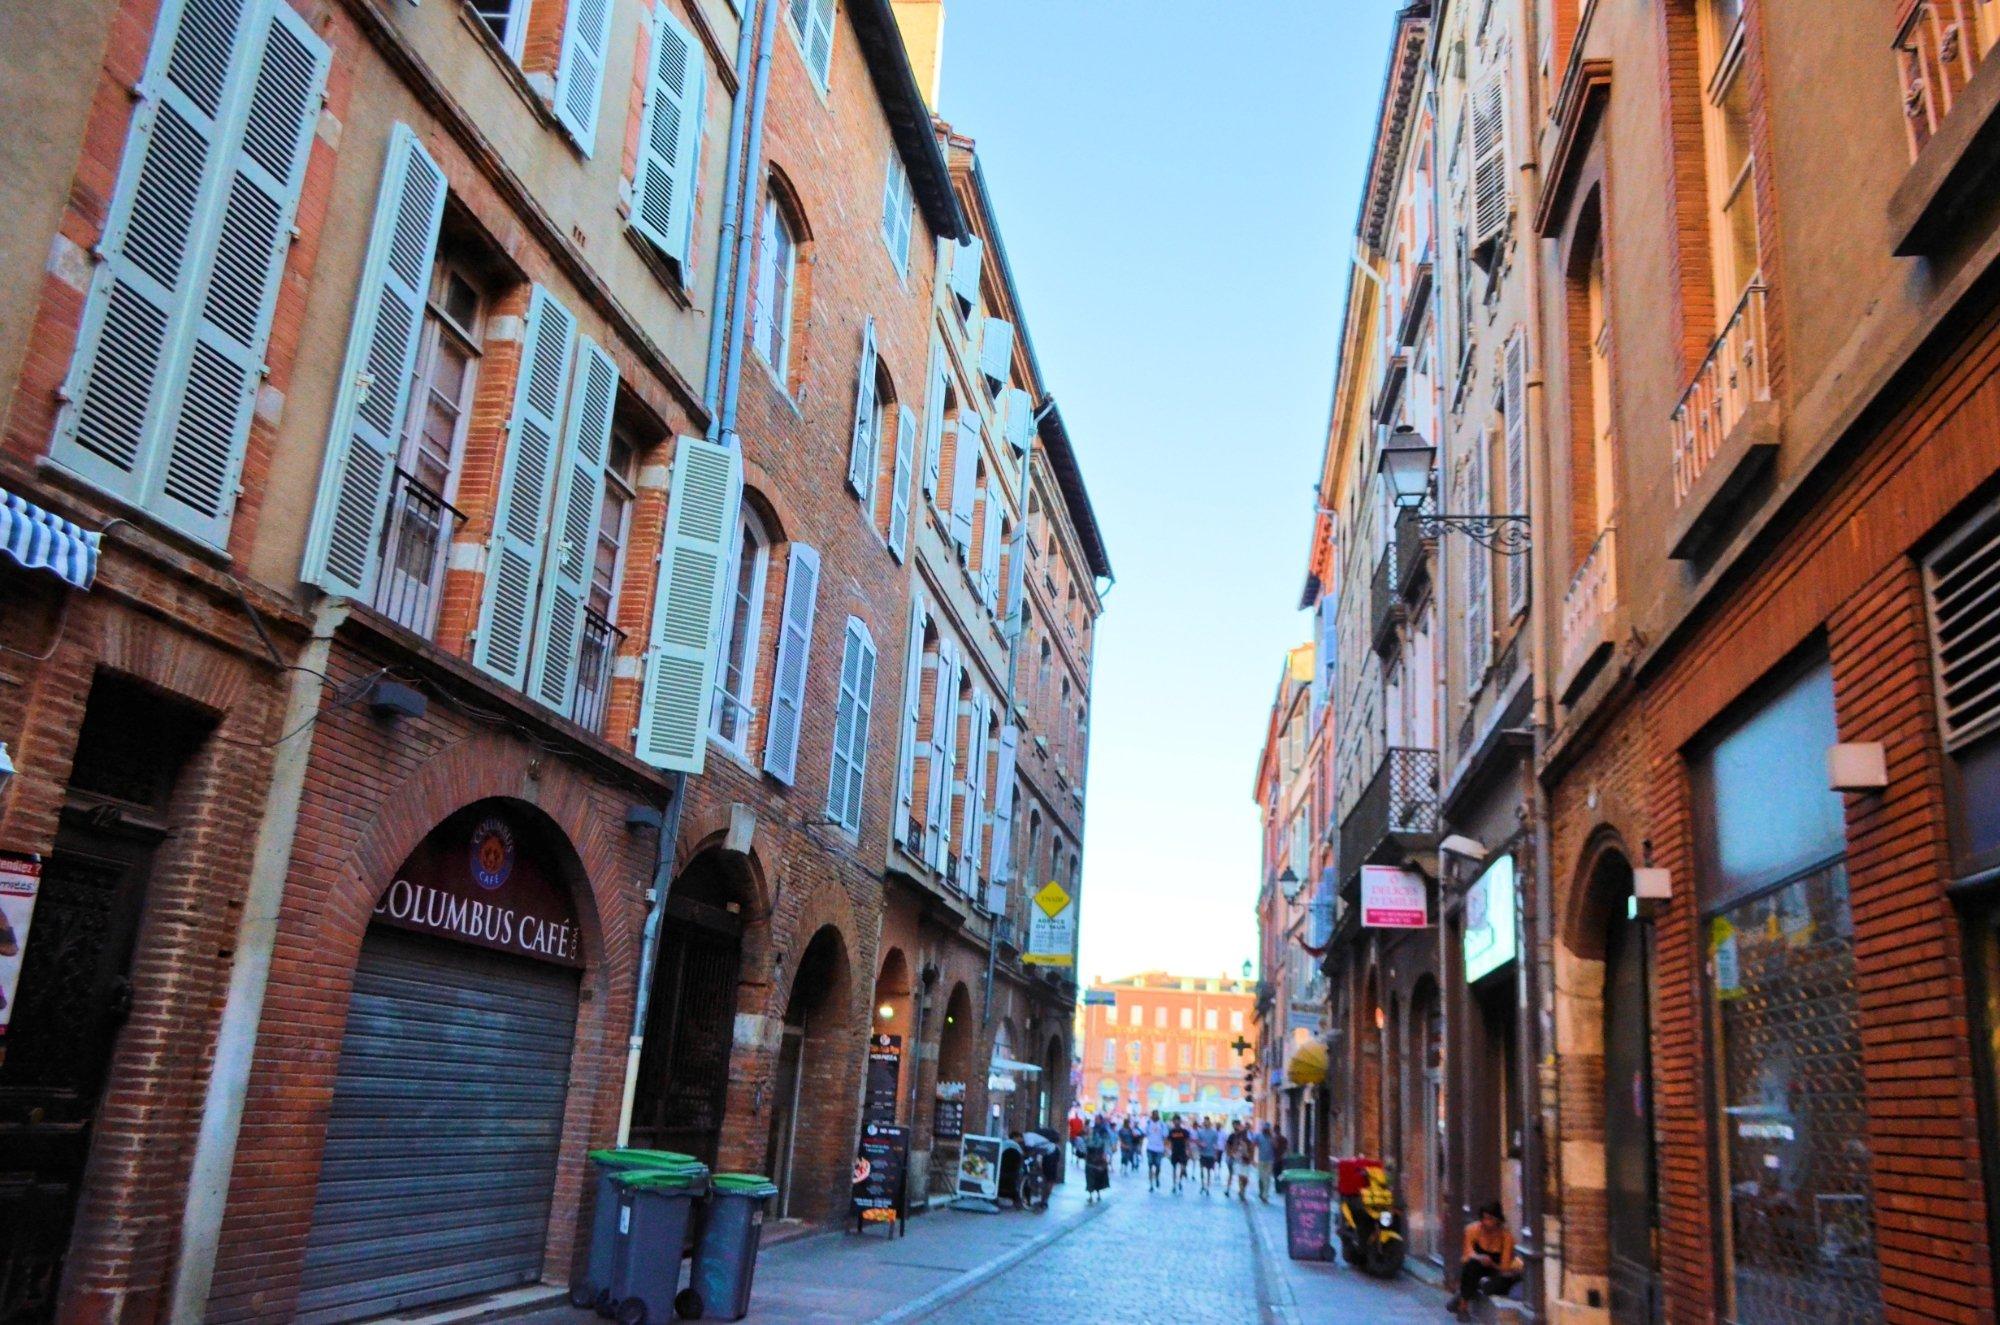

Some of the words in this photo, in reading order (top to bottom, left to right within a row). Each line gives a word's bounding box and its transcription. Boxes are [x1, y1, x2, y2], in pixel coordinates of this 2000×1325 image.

[0, 859, 33, 873] endiez
[373, 880, 514, 945] OLUMBUS
[519, 918, 570, 958] CAFÉ
